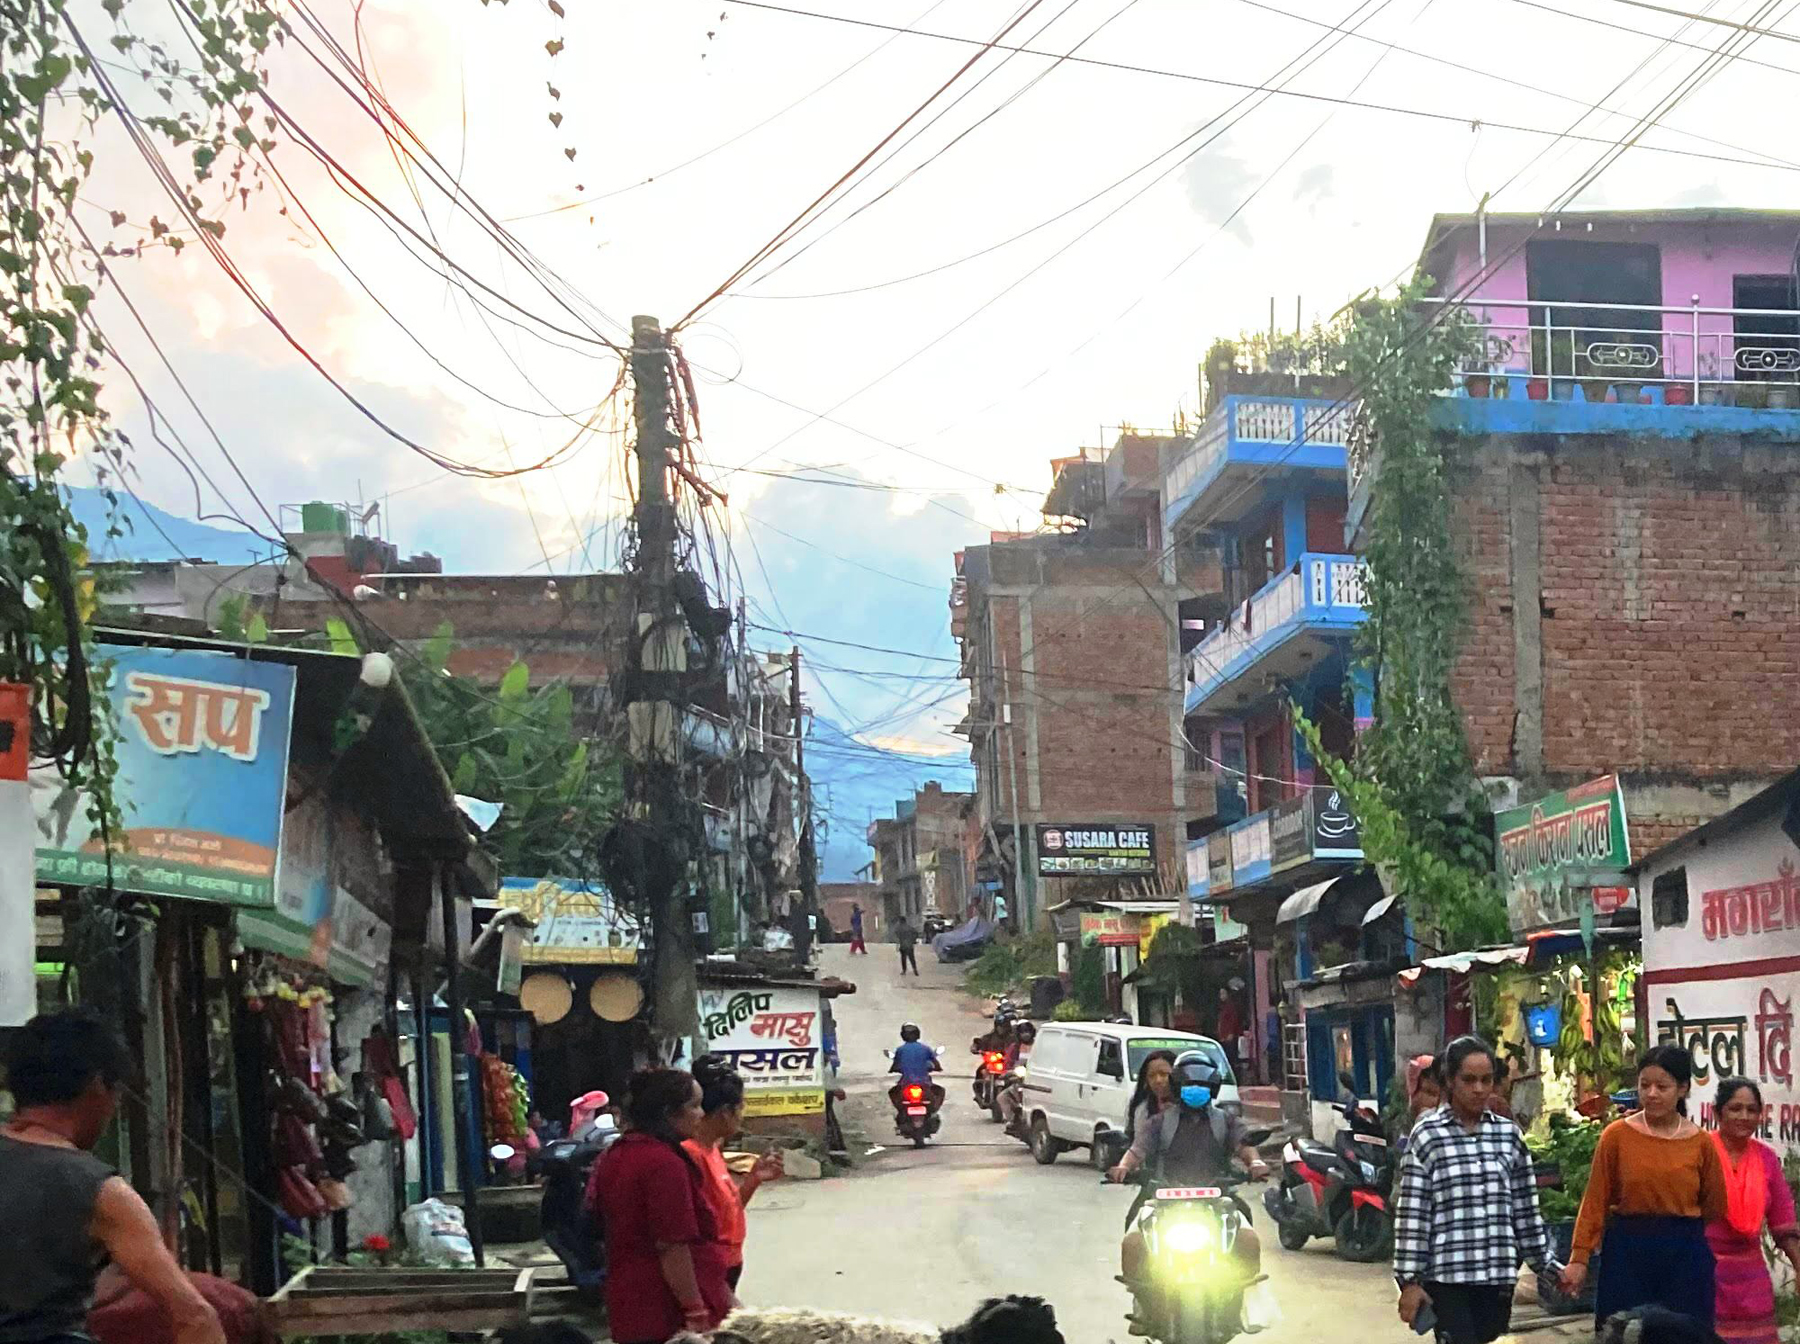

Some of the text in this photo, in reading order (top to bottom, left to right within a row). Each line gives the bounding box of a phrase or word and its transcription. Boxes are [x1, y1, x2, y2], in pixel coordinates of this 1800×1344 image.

[1064, 829, 1149, 849] SUSARA CAFE
[750, 1011, 817, 1047] मासु
